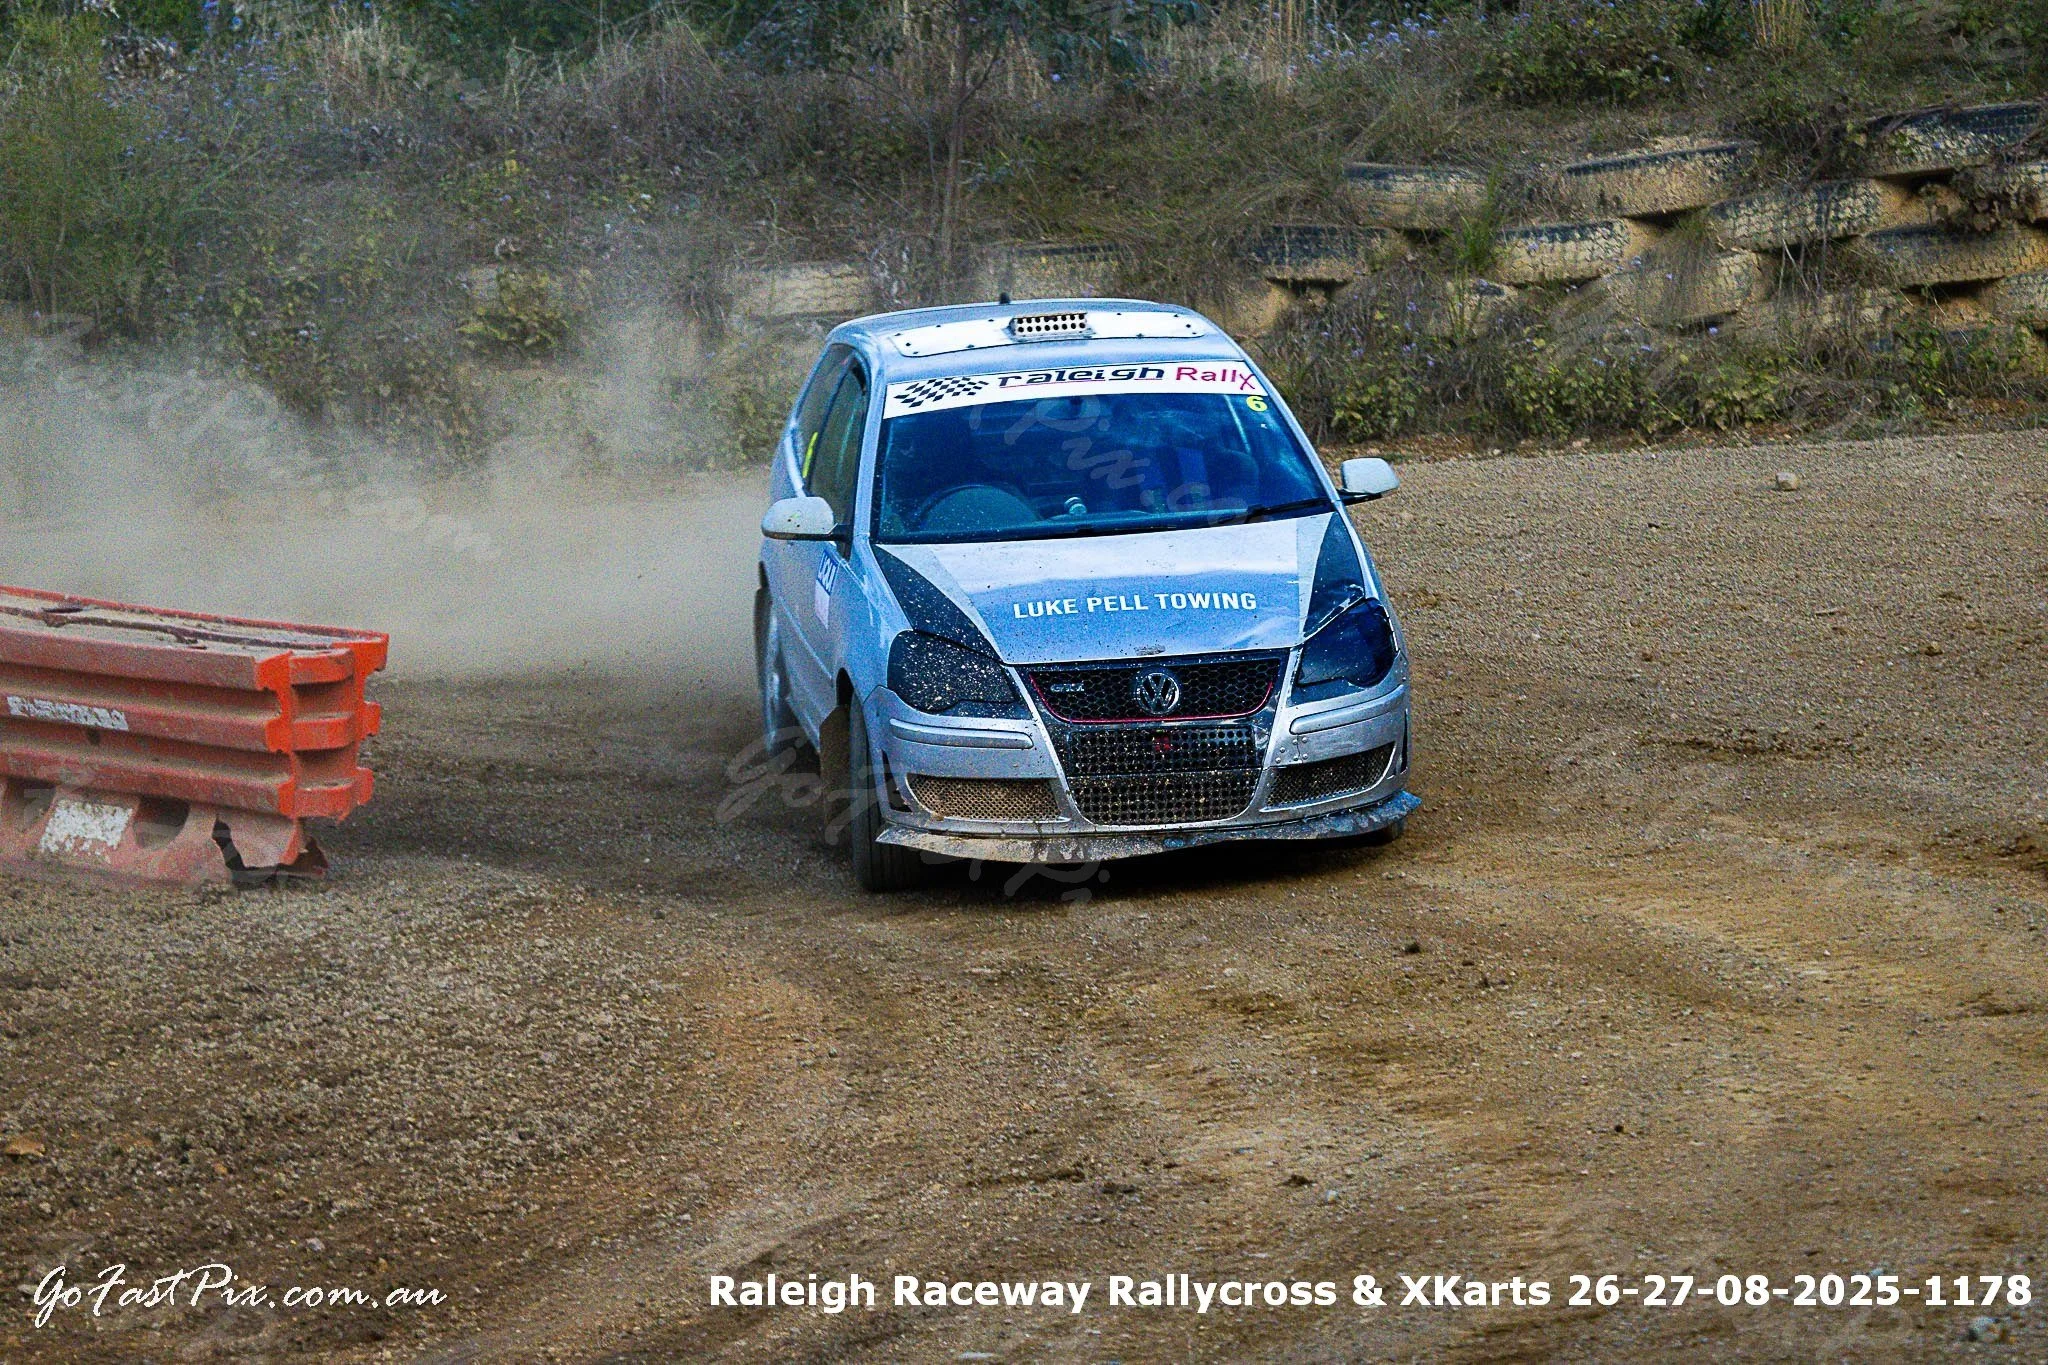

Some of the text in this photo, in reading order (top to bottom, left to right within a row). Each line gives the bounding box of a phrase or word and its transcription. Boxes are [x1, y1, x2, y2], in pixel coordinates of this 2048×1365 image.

[1246, 396, 1268, 412] 6
[1013, 592, 1257, 619] LUKE PELL TOWING
